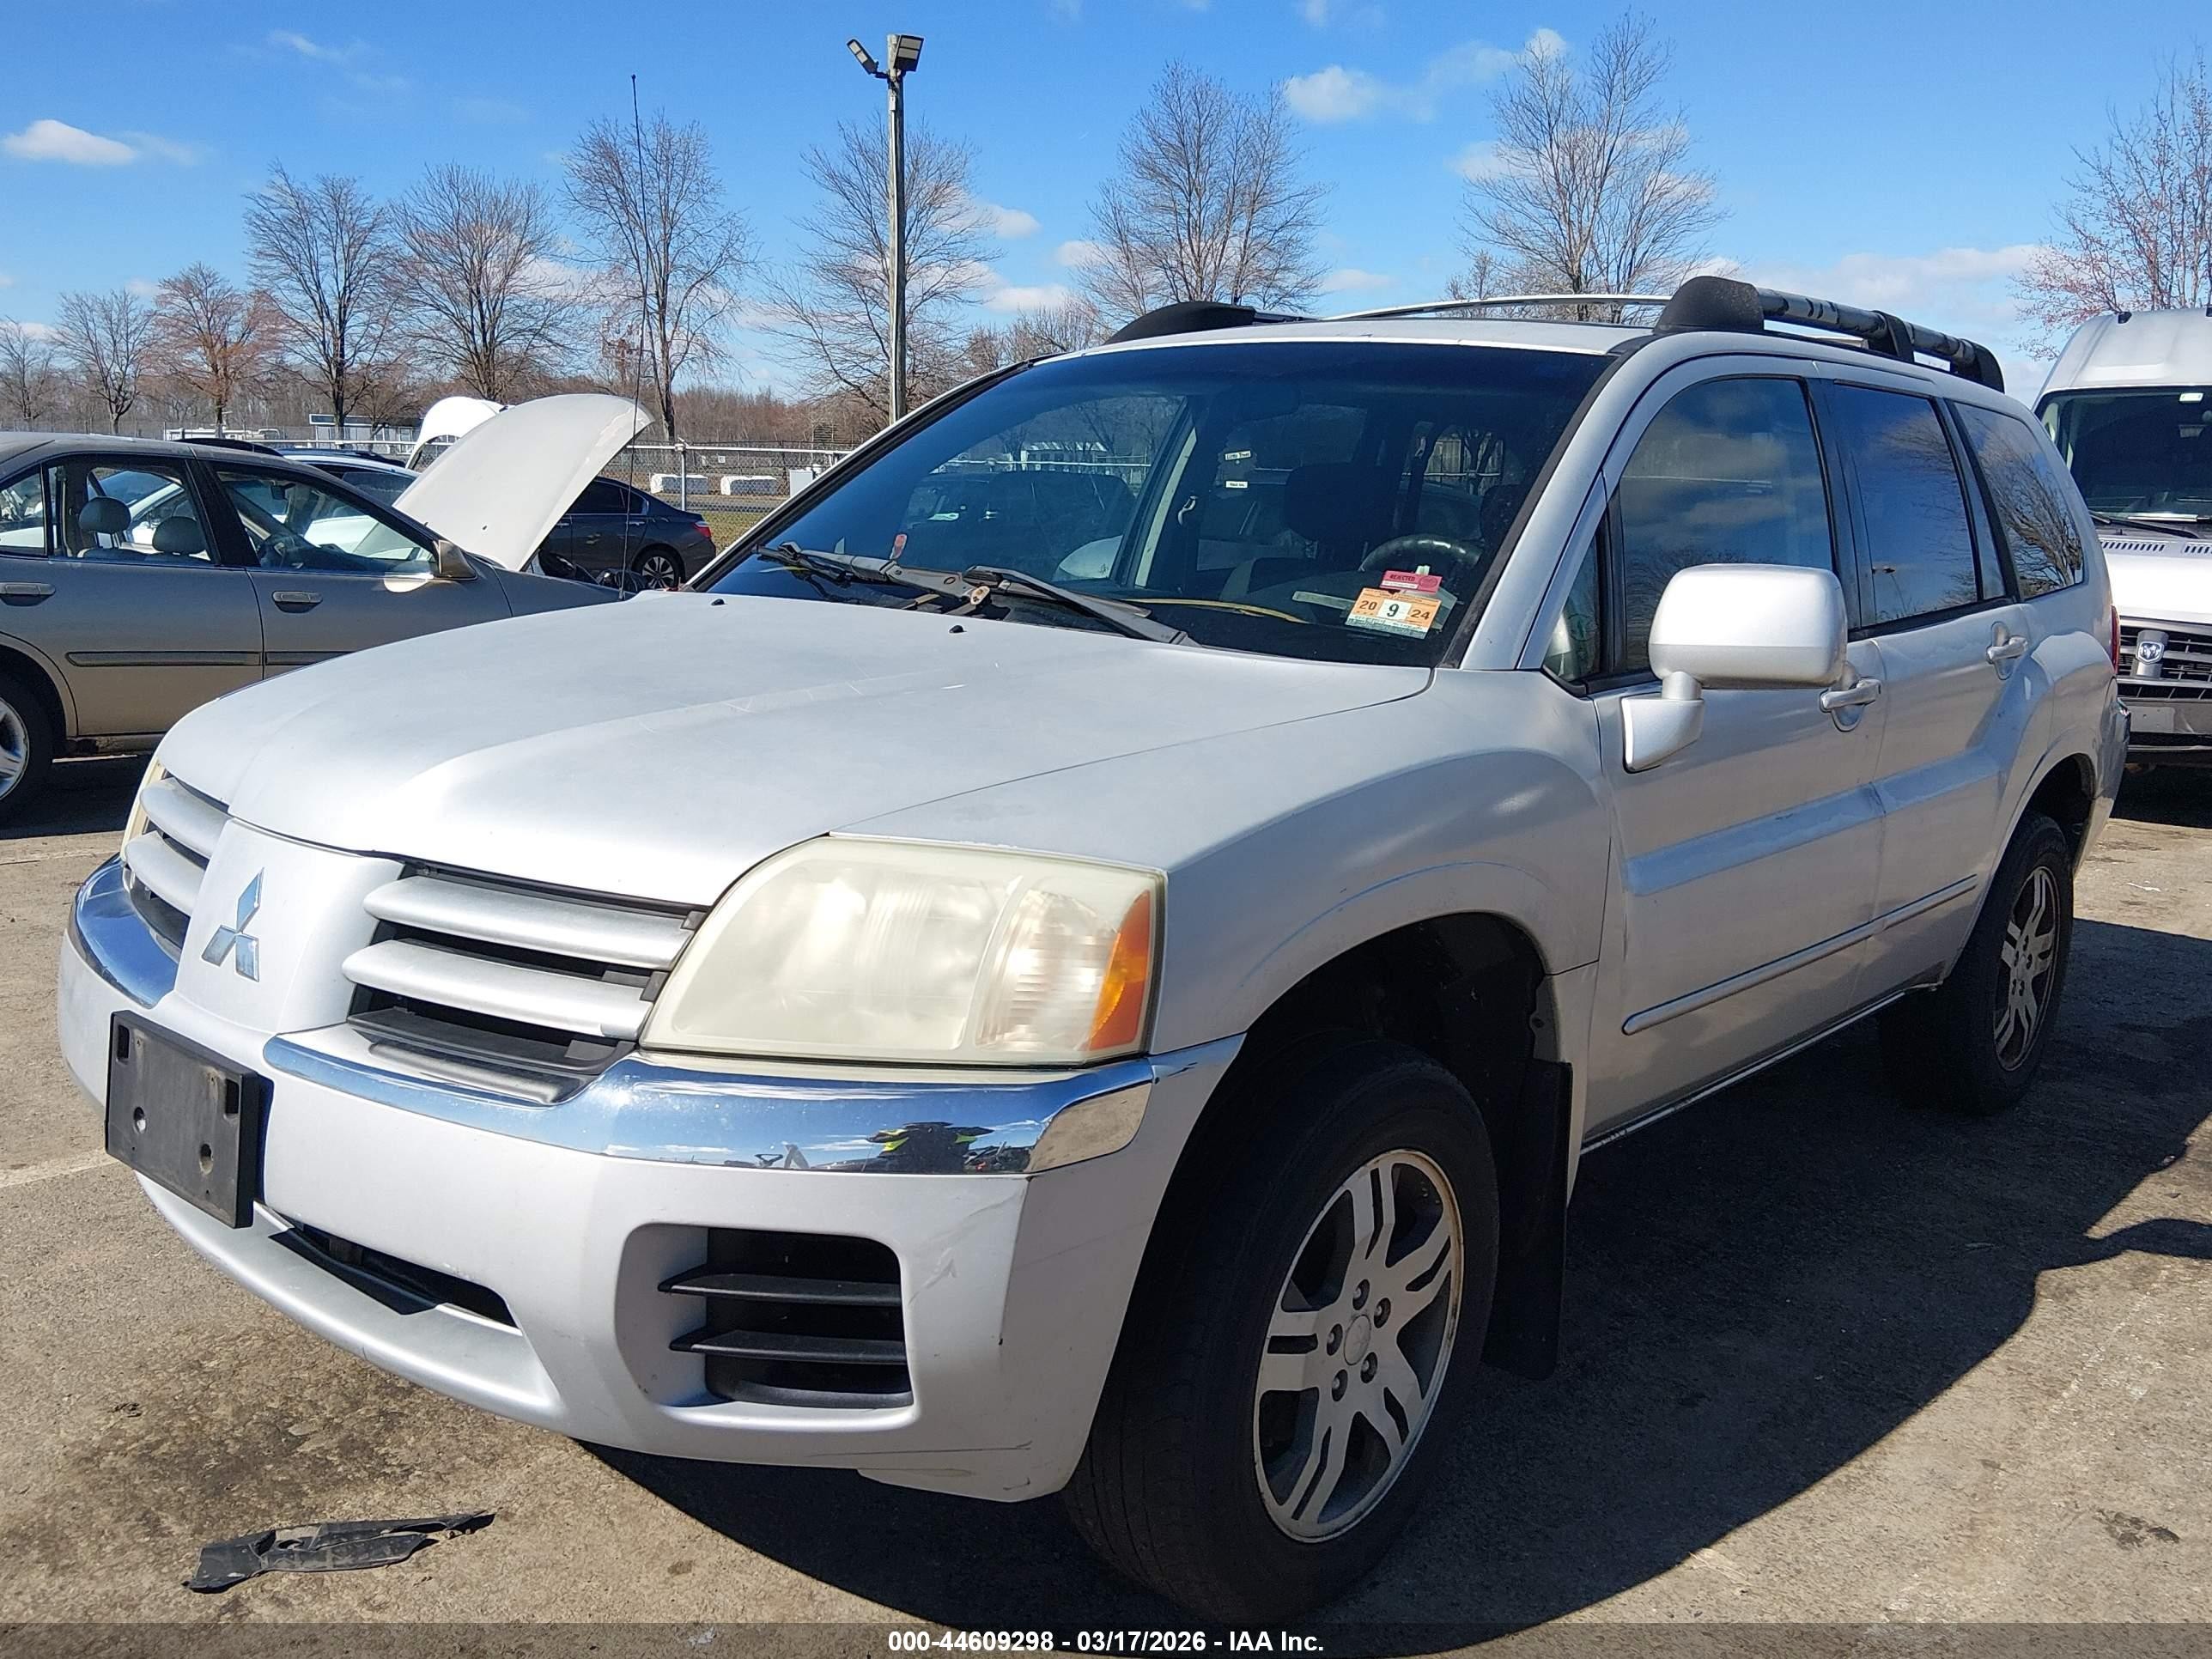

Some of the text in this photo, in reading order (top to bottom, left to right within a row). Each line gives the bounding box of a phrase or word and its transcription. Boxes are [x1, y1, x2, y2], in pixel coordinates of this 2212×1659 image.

[1389, 574, 1416, 582] REJECTED
[1359, 600, 1431, 620] 20 9 24
